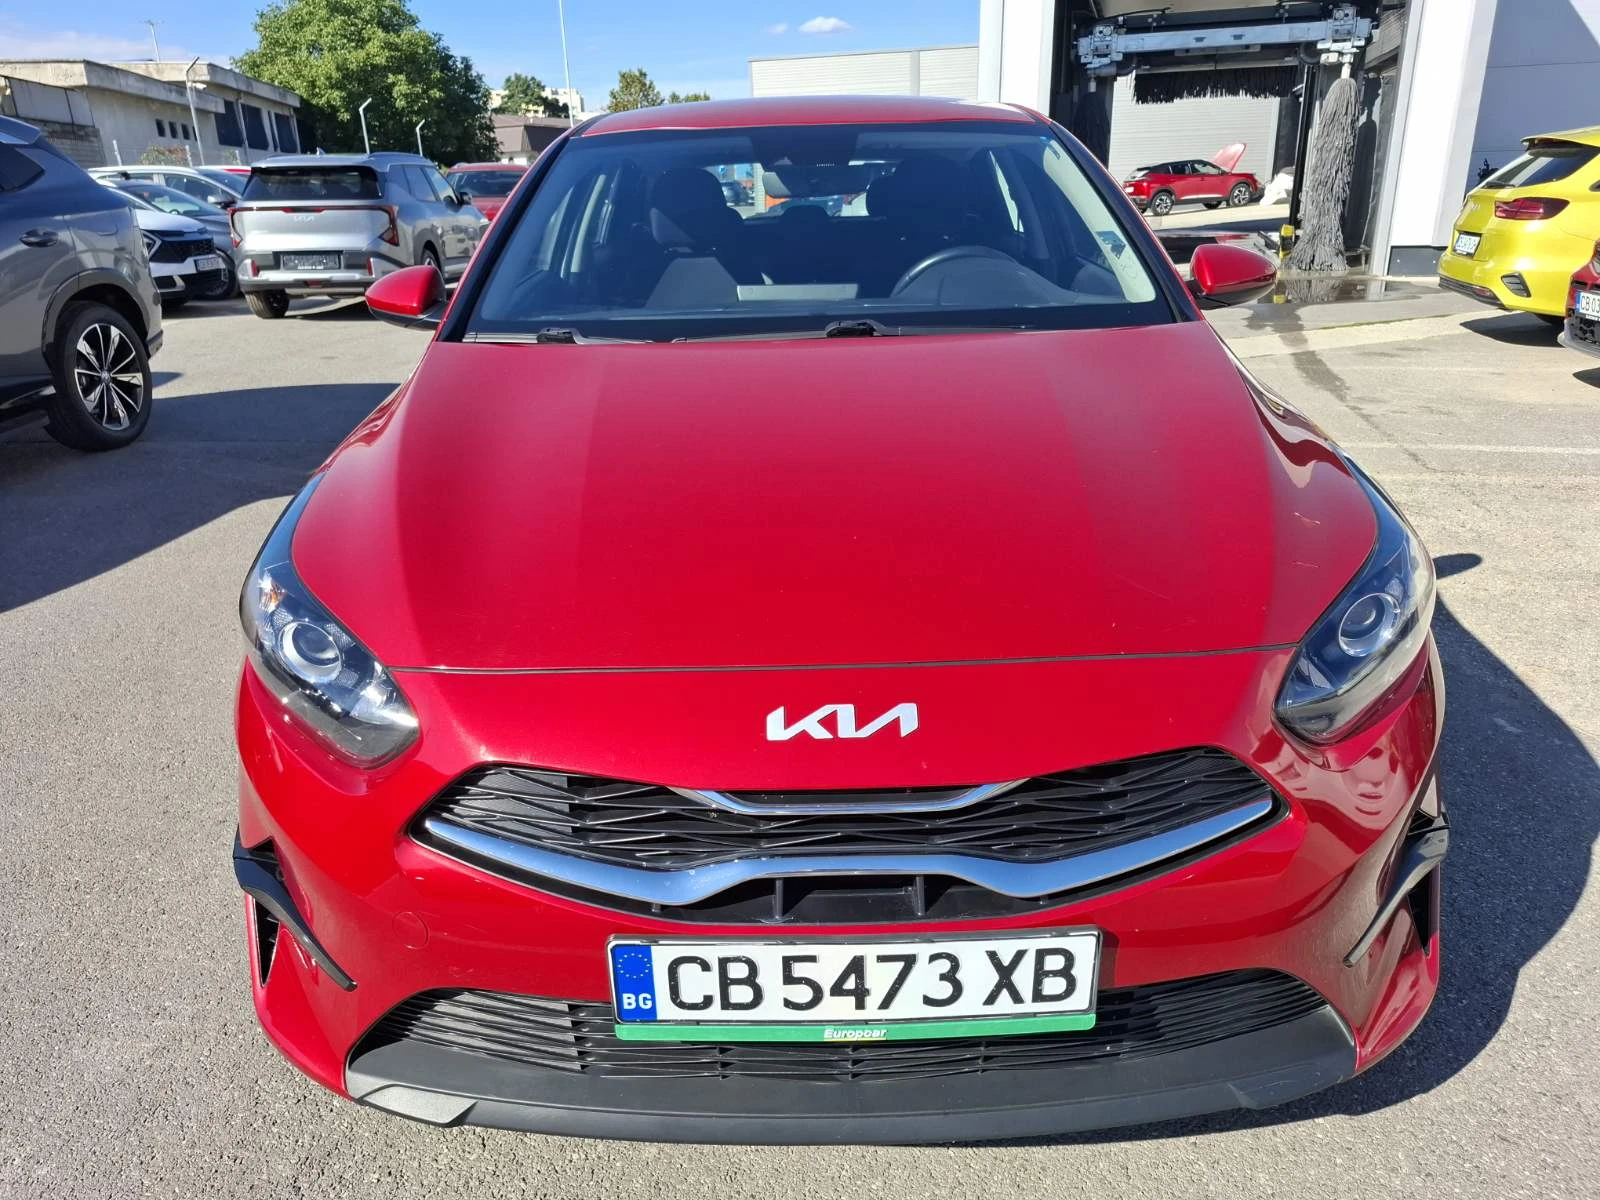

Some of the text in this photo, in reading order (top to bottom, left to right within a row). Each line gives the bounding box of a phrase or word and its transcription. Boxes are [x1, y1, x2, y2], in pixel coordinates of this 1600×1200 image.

[1581, 295, 1590, 311] CB
[766, 702, 919, 741] KIA
[667, 948, 1077, 1012] CB 5473 XB
[622, 993, 653, 1010] BG
[823, 1028, 887, 1040] Europcar
